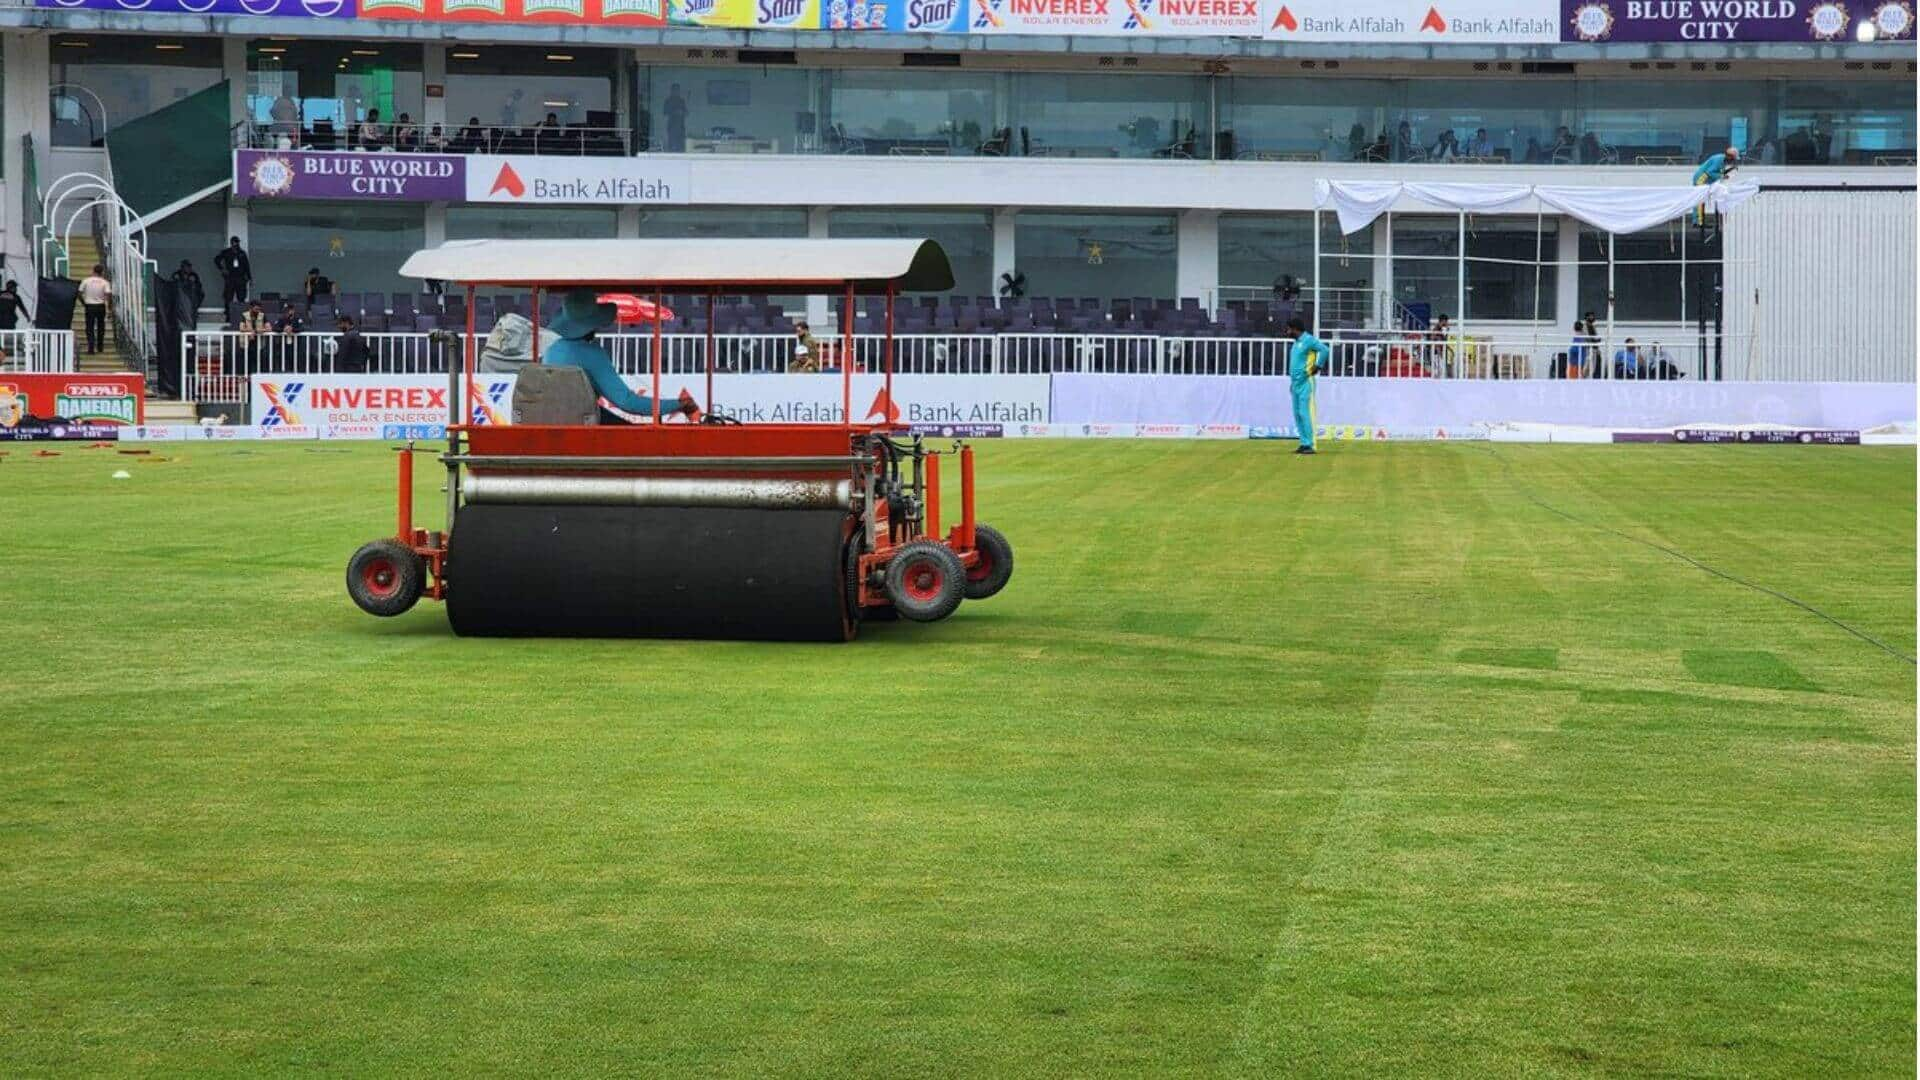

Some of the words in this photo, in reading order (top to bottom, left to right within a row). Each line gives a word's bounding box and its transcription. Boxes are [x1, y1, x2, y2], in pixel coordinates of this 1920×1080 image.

[908, 0, 953, 29] Saaf
[1010, 0, 1109, 14] INVEREX
[1159, 0, 1258, 15] INVEREX
[1626, 1, 1693, 19] BLUE
[1701, 1, 1797, 19] WORLD
[1022, 17, 1060, 25] SOLAR
[1063, 17, 1109, 25] ENERGY
[1303, 17, 1345, 33] Bank
[1349, 17, 1404, 33] Alfalah
[1452, 18, 1491, 33] Bank
[1496, 18, 1554, 34] Alfalah
[1680, 22, 1739, 39] CITY
[304, 157, 363, 174] BLUE
[369, 160, 454, 177] WORLD
[352, 177, 407, 193] CITY
[534, 178, 589, 198] Bank
[595, 178, 671, 199] Alfalah
[68, 385, 124, 396] TAPAL
[311, 388, 447, 409] INVEREX
[58, 397, 134, 425] DANEDAR
[328, 413, 378, 423] SOLAR
[383, 413, 447, 423] ENERGY
[712, 403, 766, 422] Bank
[773, 402, 845, 422] Alfalah
[908, 402, 962, 422] Bank
[968, 401, 1043, 423] Alfalah
